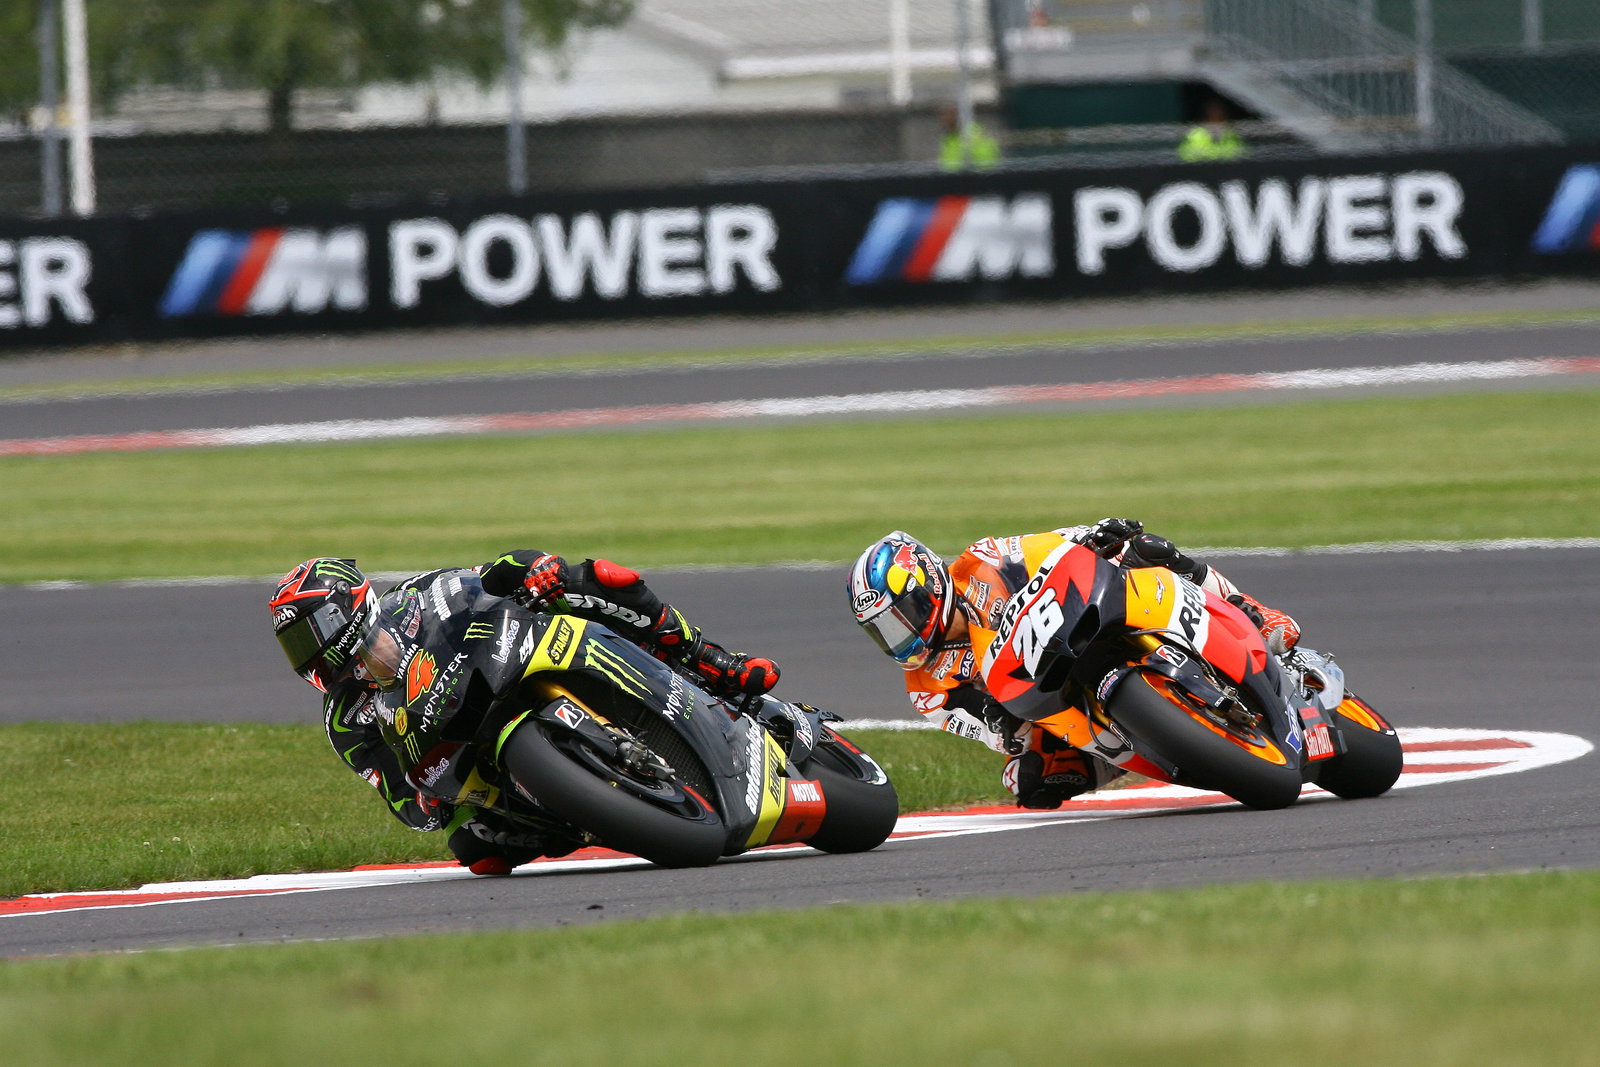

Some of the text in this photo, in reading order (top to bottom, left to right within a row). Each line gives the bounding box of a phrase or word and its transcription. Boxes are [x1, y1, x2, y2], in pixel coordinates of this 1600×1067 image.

[1074, 171, 1467, 276] POWER
[388, 203, 781, 307] POWER
[857, 592, 876, 608] Arai
[990, 565, 1053, 660] REPSOL
[335, 611, 364, 651] MONSTER
[550, 620, 572, 661] STANLEY
[1011, 587, 1065, 680] 26
[394, 643, 419, 680] YAMAHA
[406, 648, 439, 707] 4
[962, 650, 975, 678] GAS
[419, 652, 469, 733] MONSTER
[791, 783, 821, 802] MOTUL
